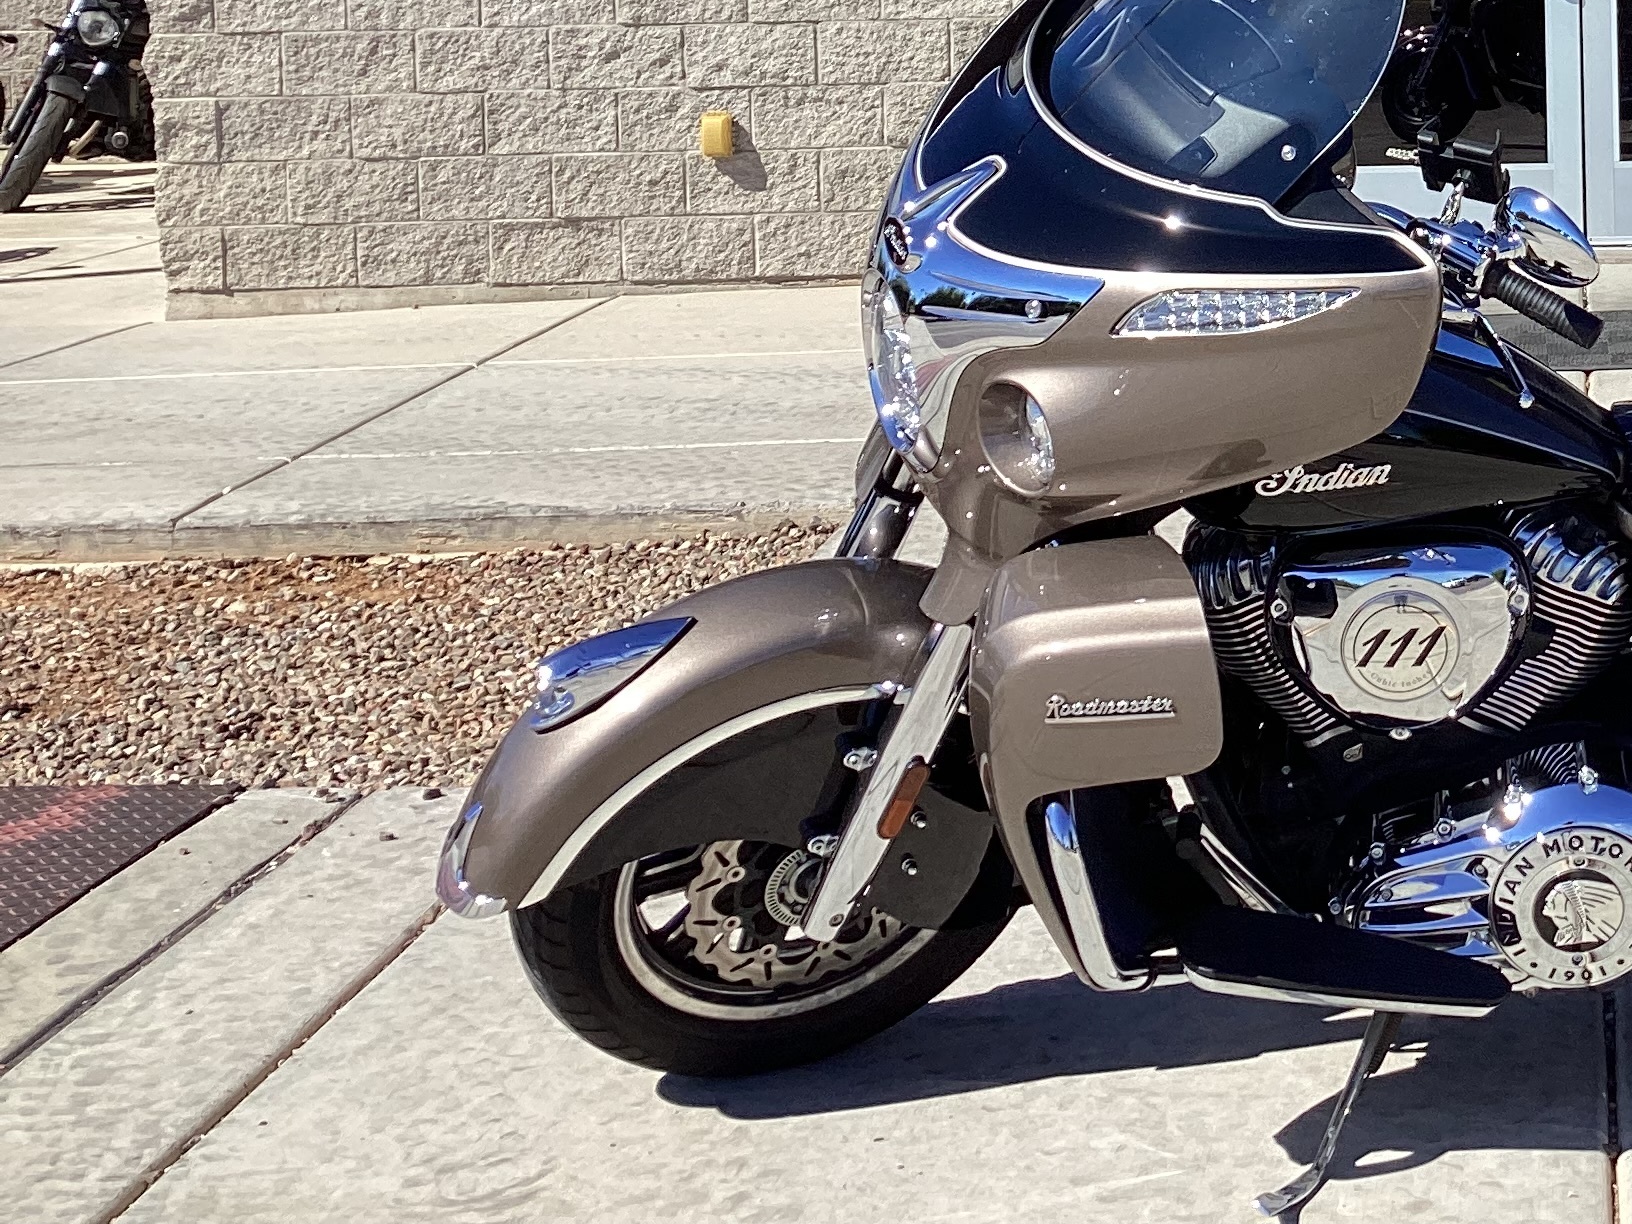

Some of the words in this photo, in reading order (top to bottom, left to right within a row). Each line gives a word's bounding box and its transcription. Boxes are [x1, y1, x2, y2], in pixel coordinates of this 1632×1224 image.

[1254, 464, 1392, 497] Indian
[1355, 625, 1447, 668] 111
[1045, 693, 1174, 720] Roadmaster
[1548, 965, 1607, 982] 1901
